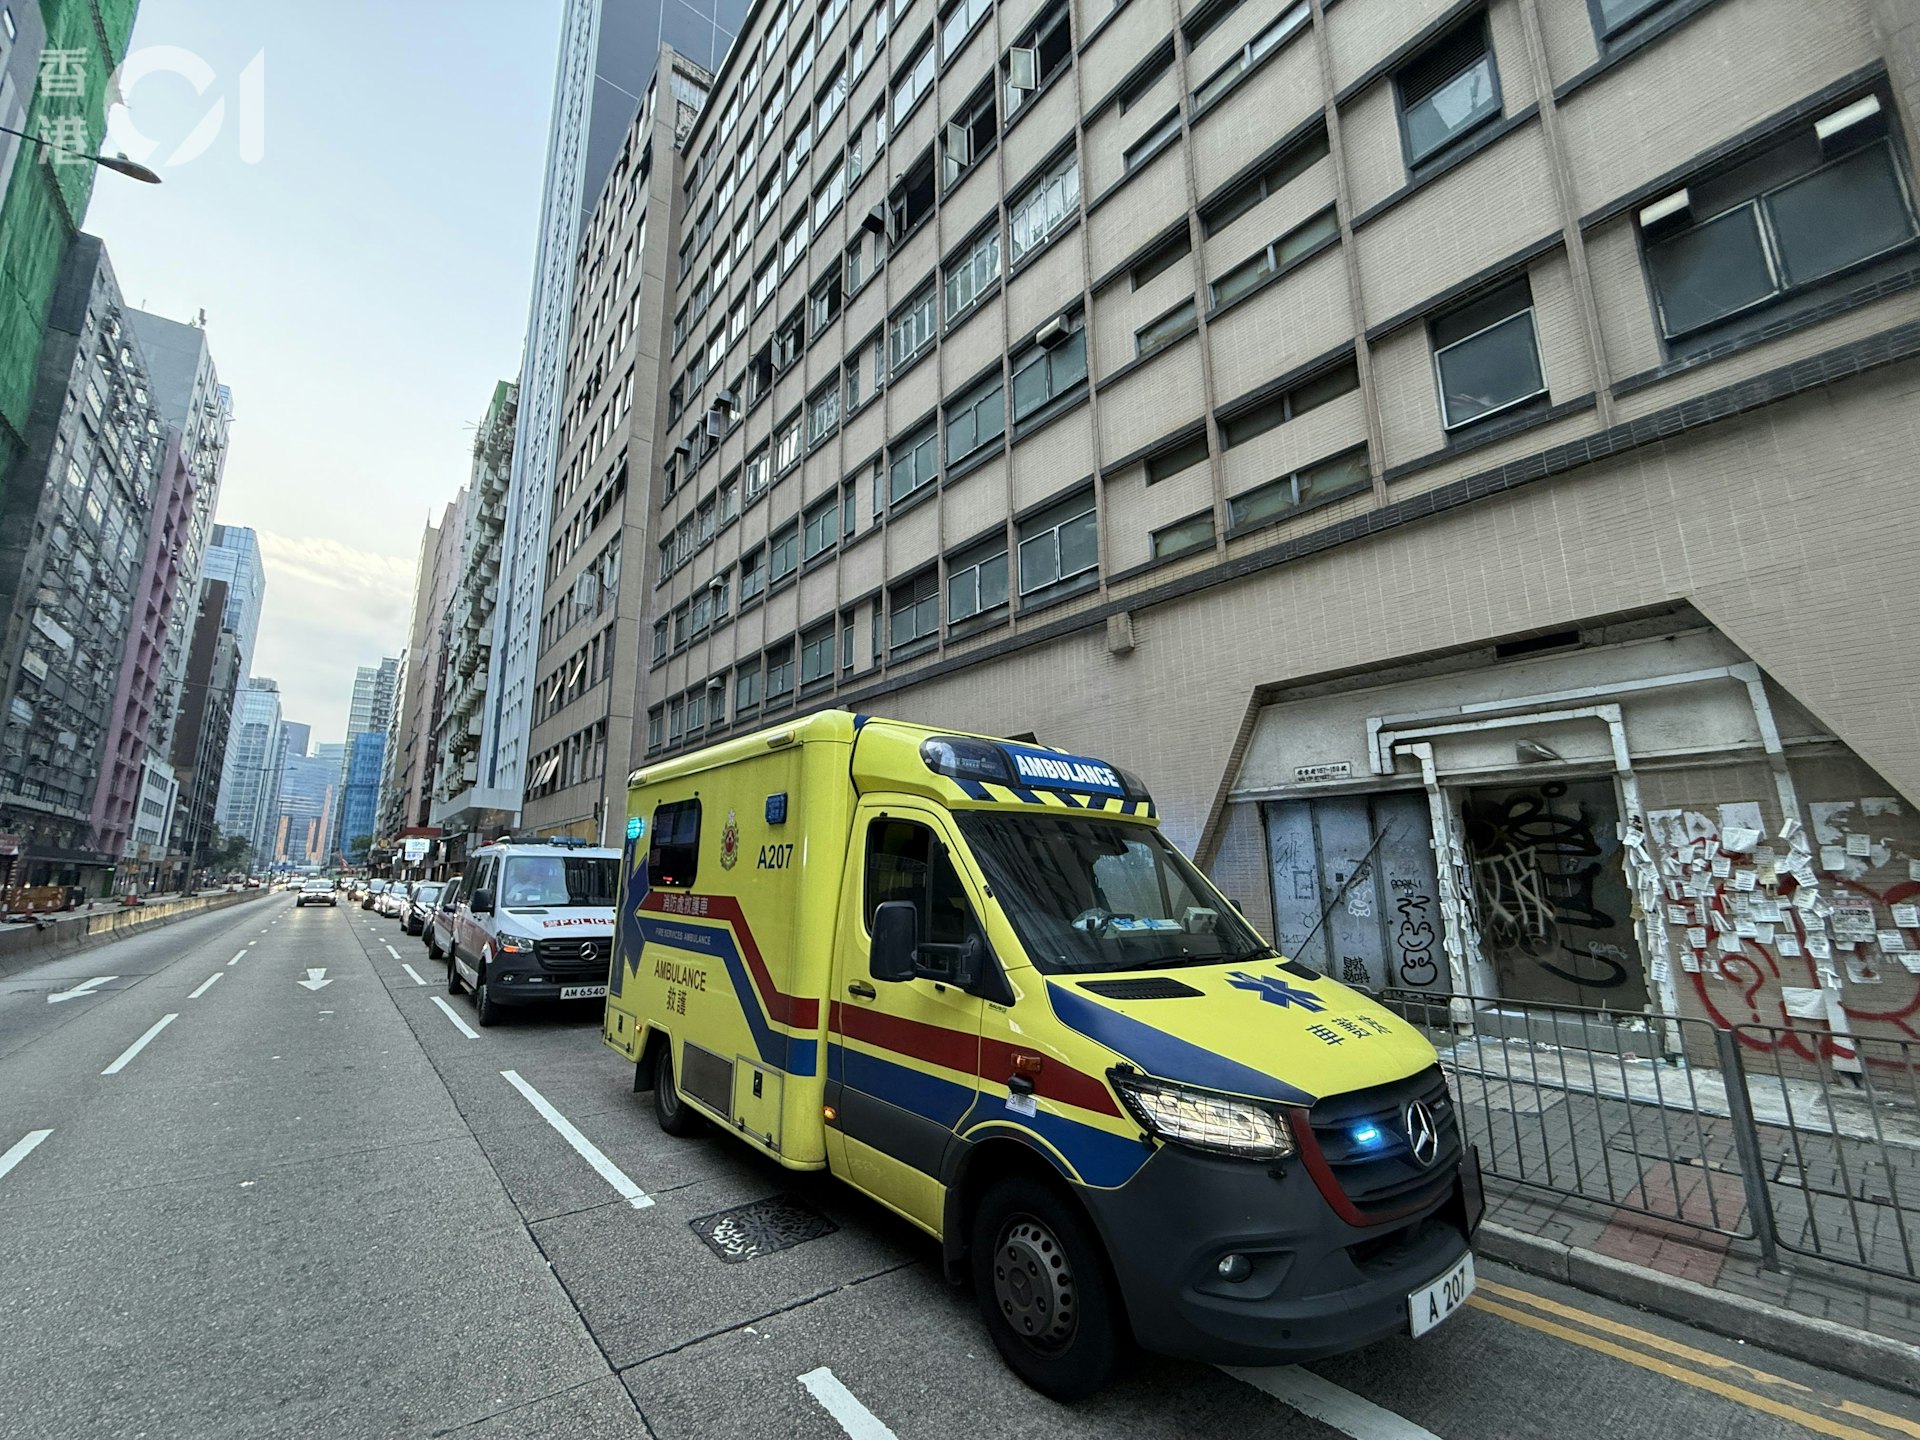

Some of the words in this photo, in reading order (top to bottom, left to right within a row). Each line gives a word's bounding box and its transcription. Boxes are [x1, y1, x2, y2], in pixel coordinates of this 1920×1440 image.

[1014, 754, 1121, 788] AMBULANCE
[757, 843, 794, 870] A207
[663, 894, 709, 916] 消防處救護車
[560, 917, 615, 927] POLICE
[655, 927, 664, 937] FIRE
[664, 929, 683, 941] SERVICES
[684, 932, 712, 946] AMBULANCE
[654, 959, 707, 992] AMBULANCE
[564, 989, 578, 998] AM
[580, 987, 606, 997] 6540
[666, 985, 688, 1016] 救護
[1429, 1291, 1439, 1324] A
[1443, 1264, 1465, 1312] 207
